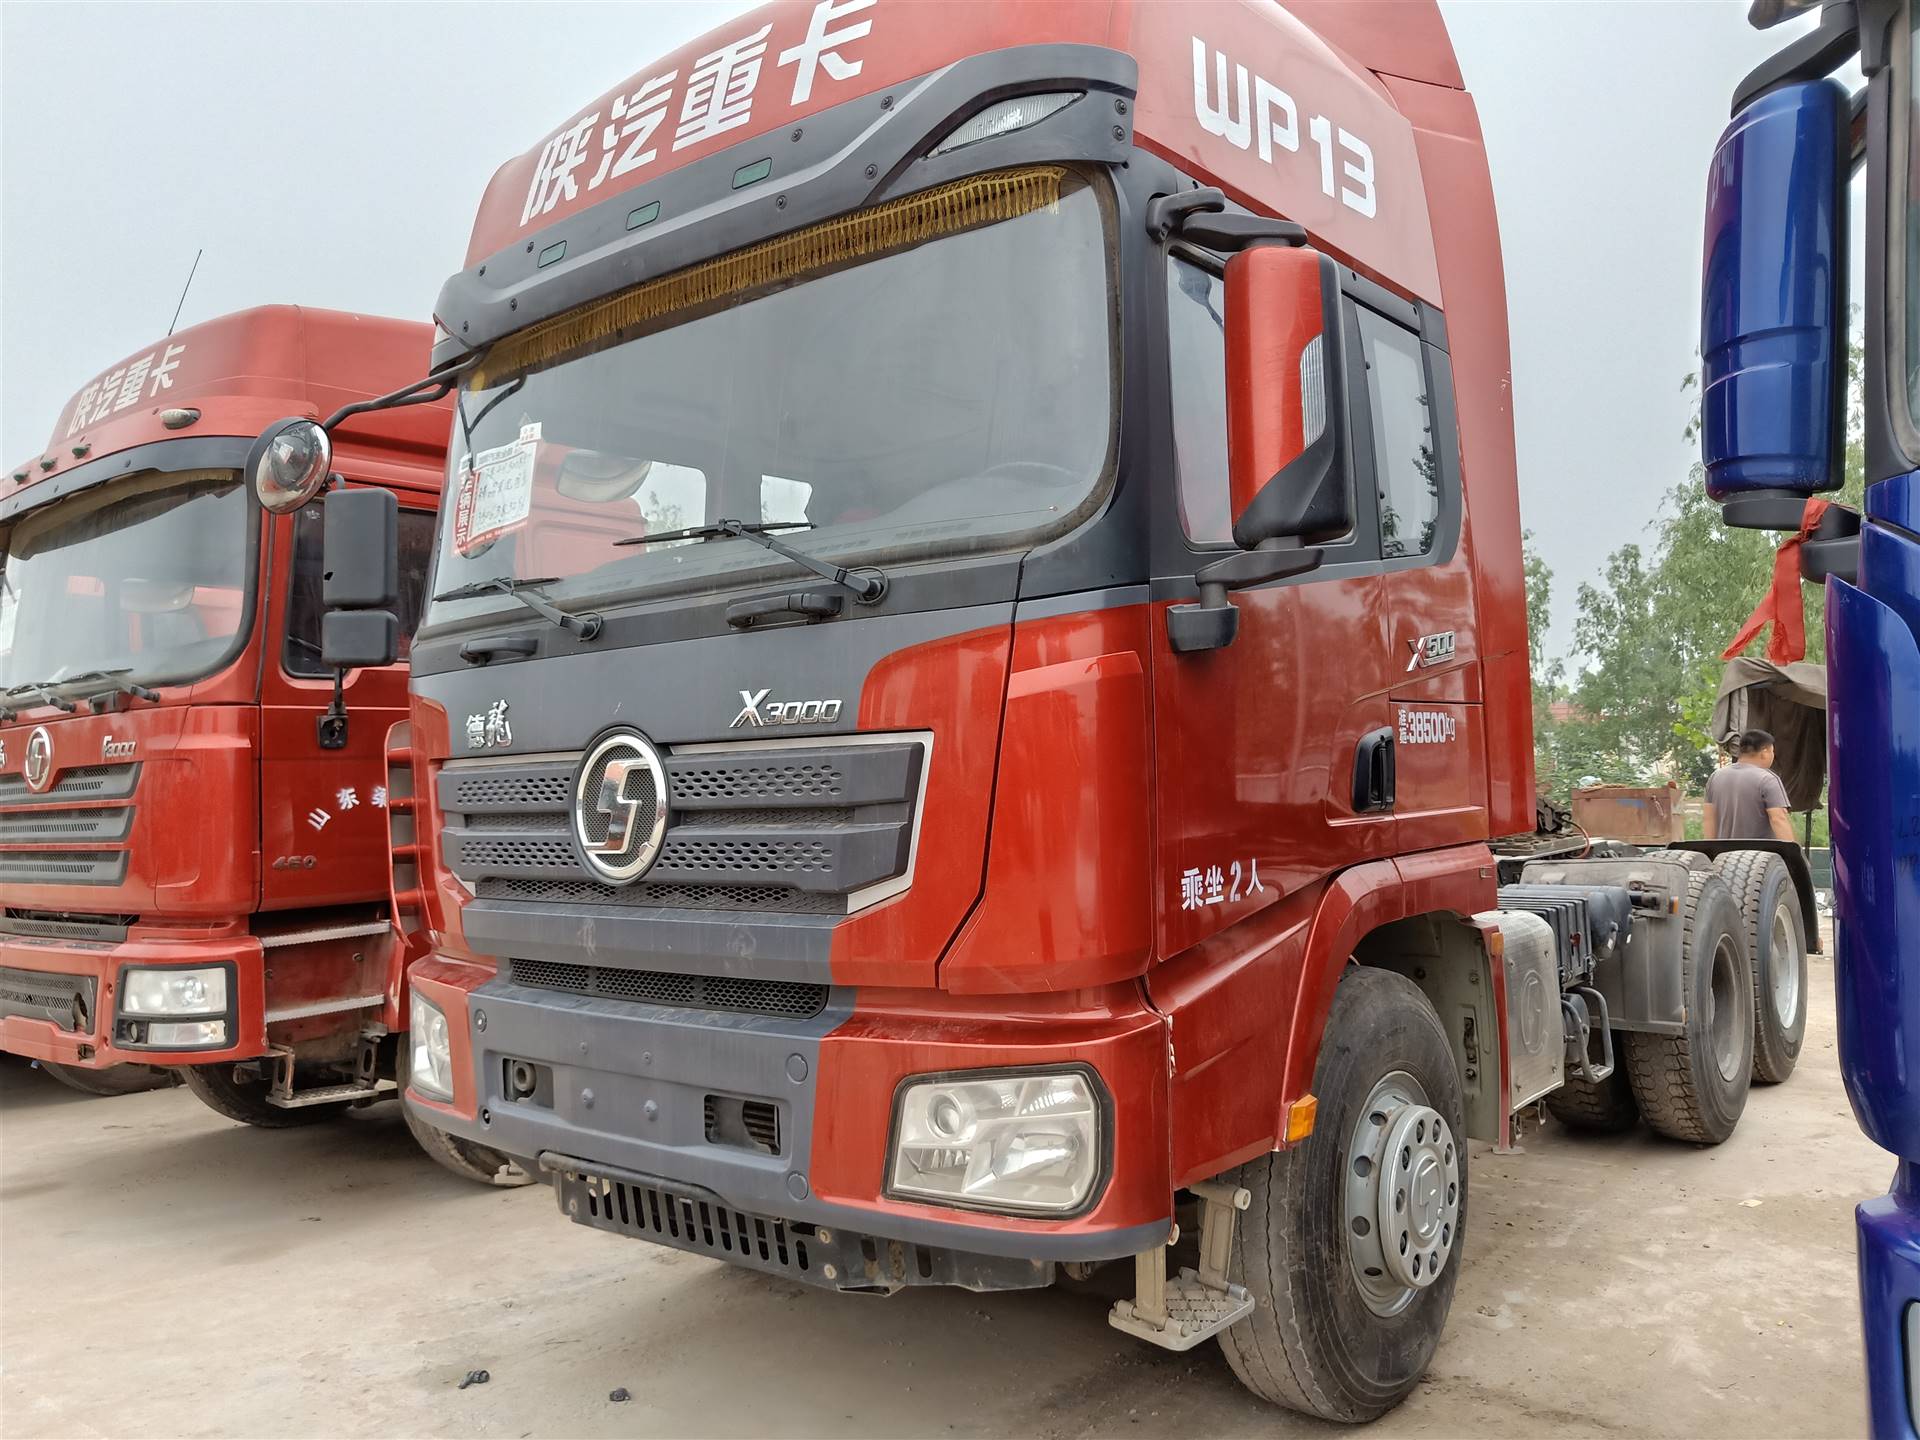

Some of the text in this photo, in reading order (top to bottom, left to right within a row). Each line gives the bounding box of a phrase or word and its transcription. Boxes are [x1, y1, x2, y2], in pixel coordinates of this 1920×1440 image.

[520, 0, 877, 227] 陕汽重卡
[66, 344, 187, 438] 陕汽重卡
[1406, 631, 1456, 672] X500
[729, 689, 843, 728] X3000
[1181, 858, 1265, 910] 乘坐2人
